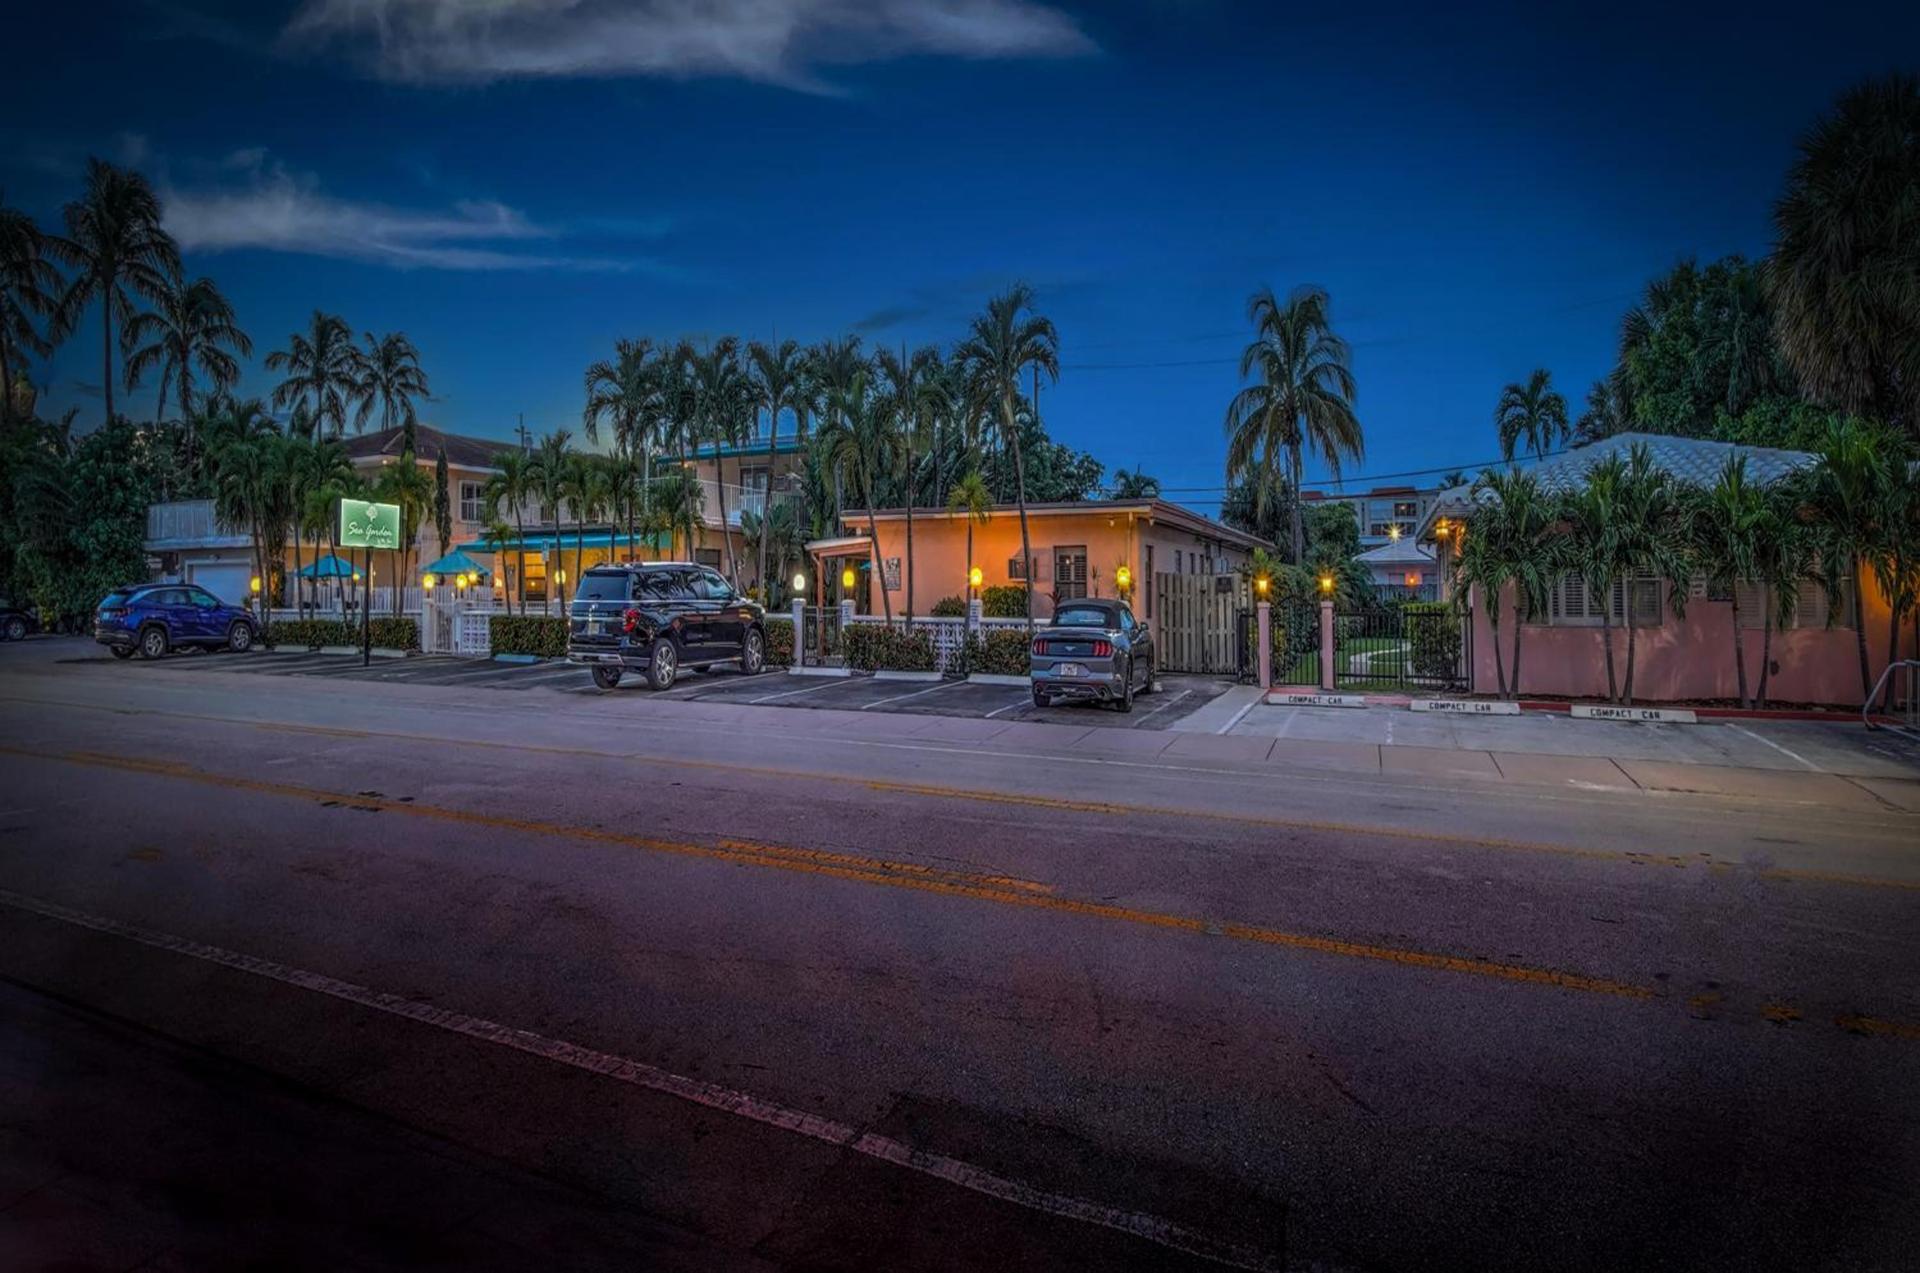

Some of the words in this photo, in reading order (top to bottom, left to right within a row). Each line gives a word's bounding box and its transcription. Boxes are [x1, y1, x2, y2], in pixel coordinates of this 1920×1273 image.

[348, 521, 364, 535] Sea
[1288, 695, 1321, 704] COMPACT
[1328, 696, 1342, 705] CAR
[1429, 702, 1466, 711] COMPACT
[1475, 703, 1491, 712] CAR
[1590, 708, 1632, 718] COMPACT
[1642, 710, 1660, 720] CAR
